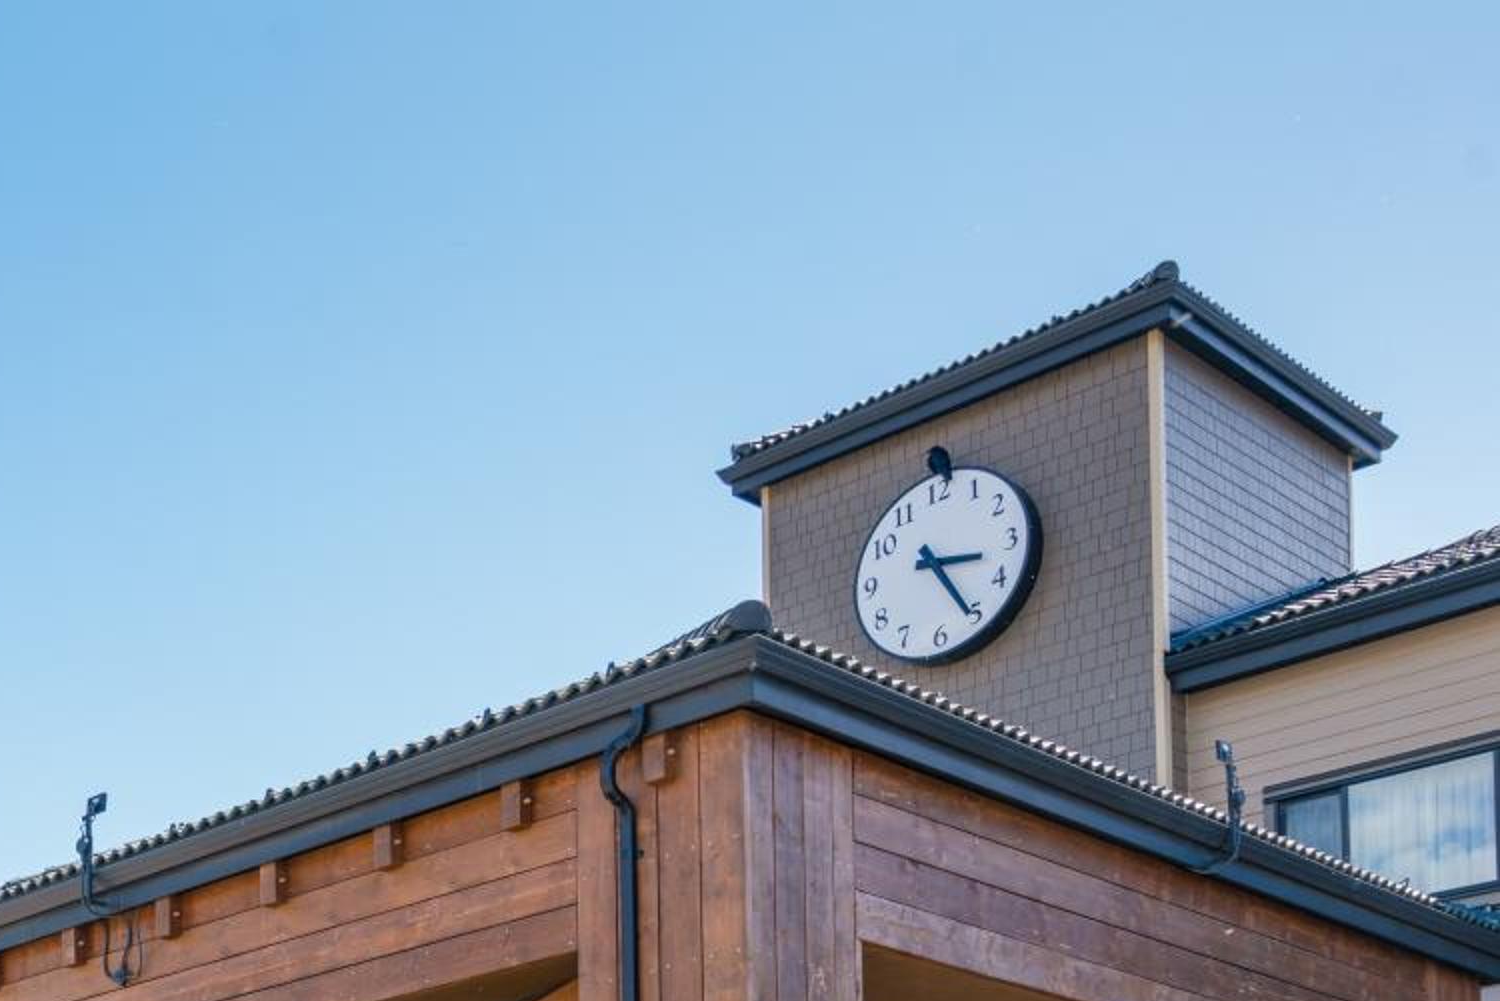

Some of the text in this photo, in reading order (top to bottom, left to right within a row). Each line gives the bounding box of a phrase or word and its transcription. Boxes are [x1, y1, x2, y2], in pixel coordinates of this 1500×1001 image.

[927, 479, 950, 506] 12
[970, 479, 979, 500] 1
[894, 503, 914, 528] 11
[991, 493, 1005, 517] 2
[874, 533, 897, 560] 10
[1004, 526, 1019, 550] 3
[864, 576, 878, 600] 9
[991, 565, 1007, 588] 4
[874, 607, 889, 631] 8
[968, 601, 983, 625] 5
[897, 624, 910, 648] 7
[933, 624, 948, 647] 6
